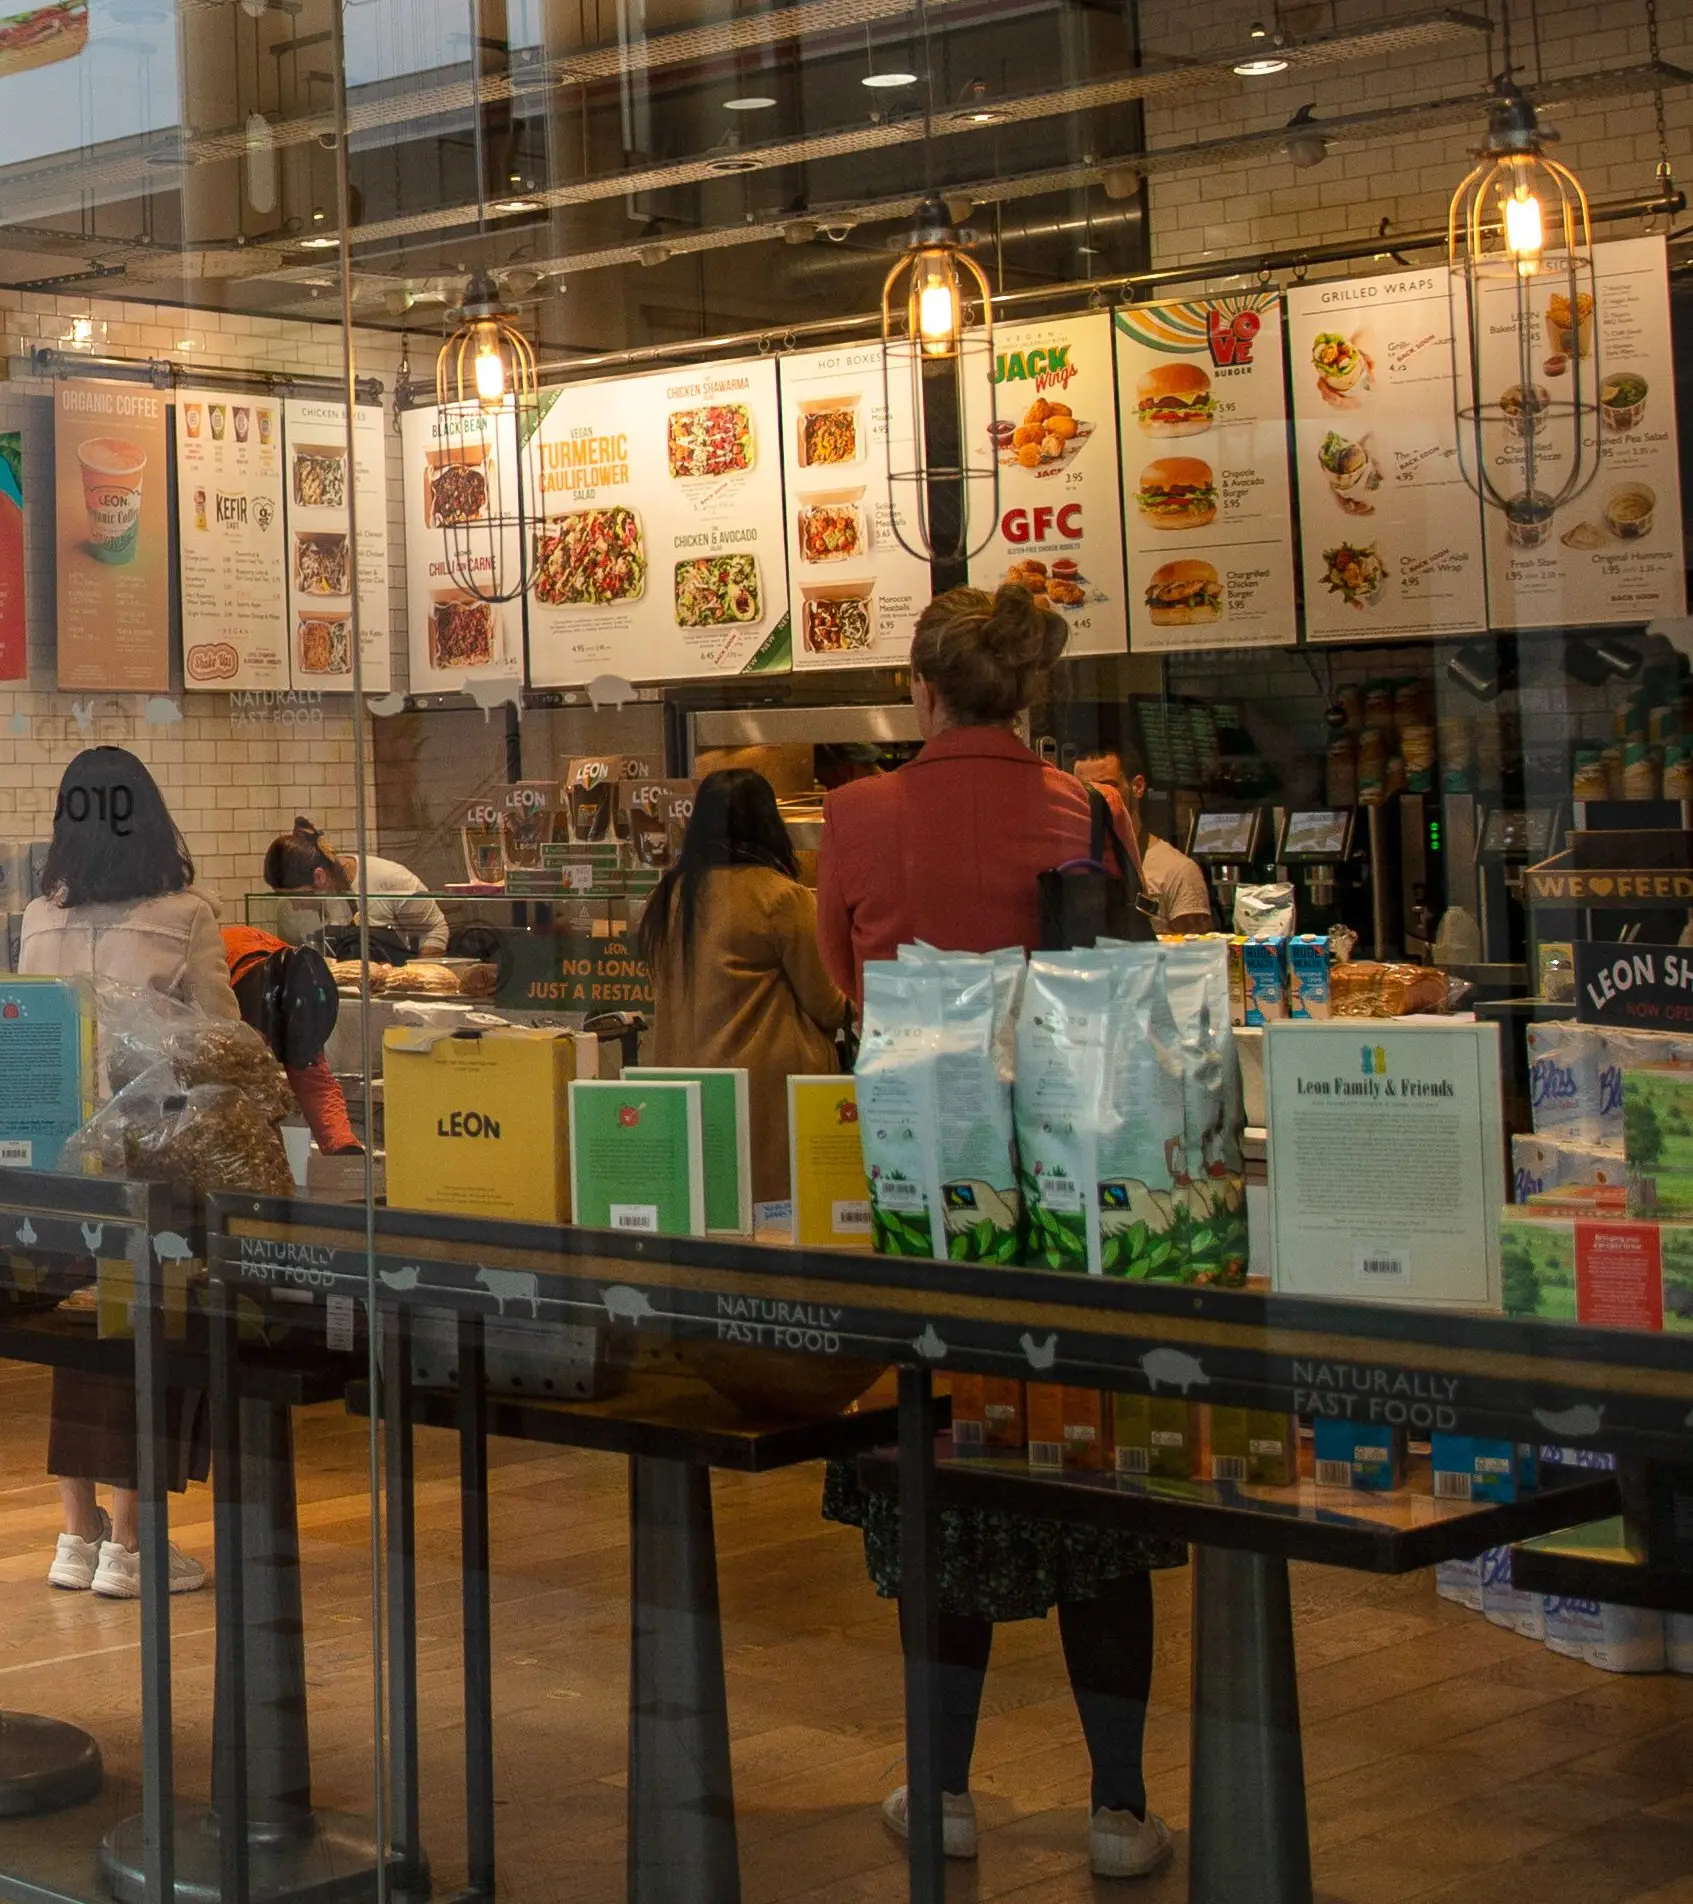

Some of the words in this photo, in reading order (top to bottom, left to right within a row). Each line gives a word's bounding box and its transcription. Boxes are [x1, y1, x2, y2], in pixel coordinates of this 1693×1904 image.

[1321, 286, 1378, 304] GRILLED
[1385, 278, 1434, 295] WRAPS
[818, 358, 841, 370] HOT
[846, 352, 883, 367] BOXES
[987, 344, 1072, 384] JACK
[1035, 363, 1078, 394] Wings
[1214, 367, 1253, 378] BURGER
[667, 384, 701, 400] CHICKEN
[702, 377, 750, 394] SHAWARMA
[62, 390, 114, 415] ORGANIC
[116, 395, 159, 418] COFFEE
[302, 407, 339, 420] CHICKEN
[1218, 402, 1236, 412] 5.95
[432, 421, 461, 438] BLACK
[464, 417, 488, 433] BEAN
[570, 427, 593, 438] VEGAN
[537, 433, 628, 470] TURMERIC
[538, 464, 629, 493] CAULIFLOWER
[1231, 477, 1265, 487] Avocado
[572, 489, 596, 501] SALAD
[1223, 488, 1249, 499] Burger
[1223, 499, 1241, 509] 5.95
[216, 493, 248, 524] KEFIR
[1001, 503, 1084, 544] GFC
[674, 533, 709, 549] CHICKEN
[719, 528, 758, 544] AVOCADO
[429, 560, 455, 577] CHILLI
[467, 555, 496, 573] CARNE
[1226, 568, 1270, 580] Chargrilled
[1227, 579, 1259, 589] Chicken
[1227, 588, 1254, 599] Burger
[1227, 600, 1245, 610] 5.95
[229, 690, 324, 708] NATURALLY
[230, 711, 265, 727] FAST
[273, 708, 324, 726] FOOD
[576, 762, 609, 780] LEON
[506, 789, 546, 808] LEON
[1533, 876, 1585, 897] WE
[1616, 876, 1693, 898] FEED
[562, 959, 592, 976] NO
[597, 960, 651, 978] LONG
[527, 982, 569, 1000] JUST
[572, 983, 585, 999] A
[591, 984, 656, 1001] RESTAU
[1586, 953, 1656, 1011] LEON
[1625, 1003, 1658, 1017] NOW
[1296, 1077, 1330, 1096] Leon
[1334, 1077, 1380, 1100] Family
[1384, 1079, 1396, 1096] &
[1401, 1078, 1454, 1097] Friends
[437, 1111, 501, 1139] LEON
[241, 1238, 336, 1265] NATURALLY
[241, 1260, 280, 1283] FAST
[285, 1264, 335, 1288] FOOD
[716, 1295, 842, 1328] NATURALLY
[716, 1319, 769, 1347] FAST
[774, 1325, 840, 1354] FOOD
[1292, 1361, 1459, 1401] NATURALLY
[1292, 1389, 1359, 1420] FAST
[1368, 1396, 1457, 1430] FOOD
